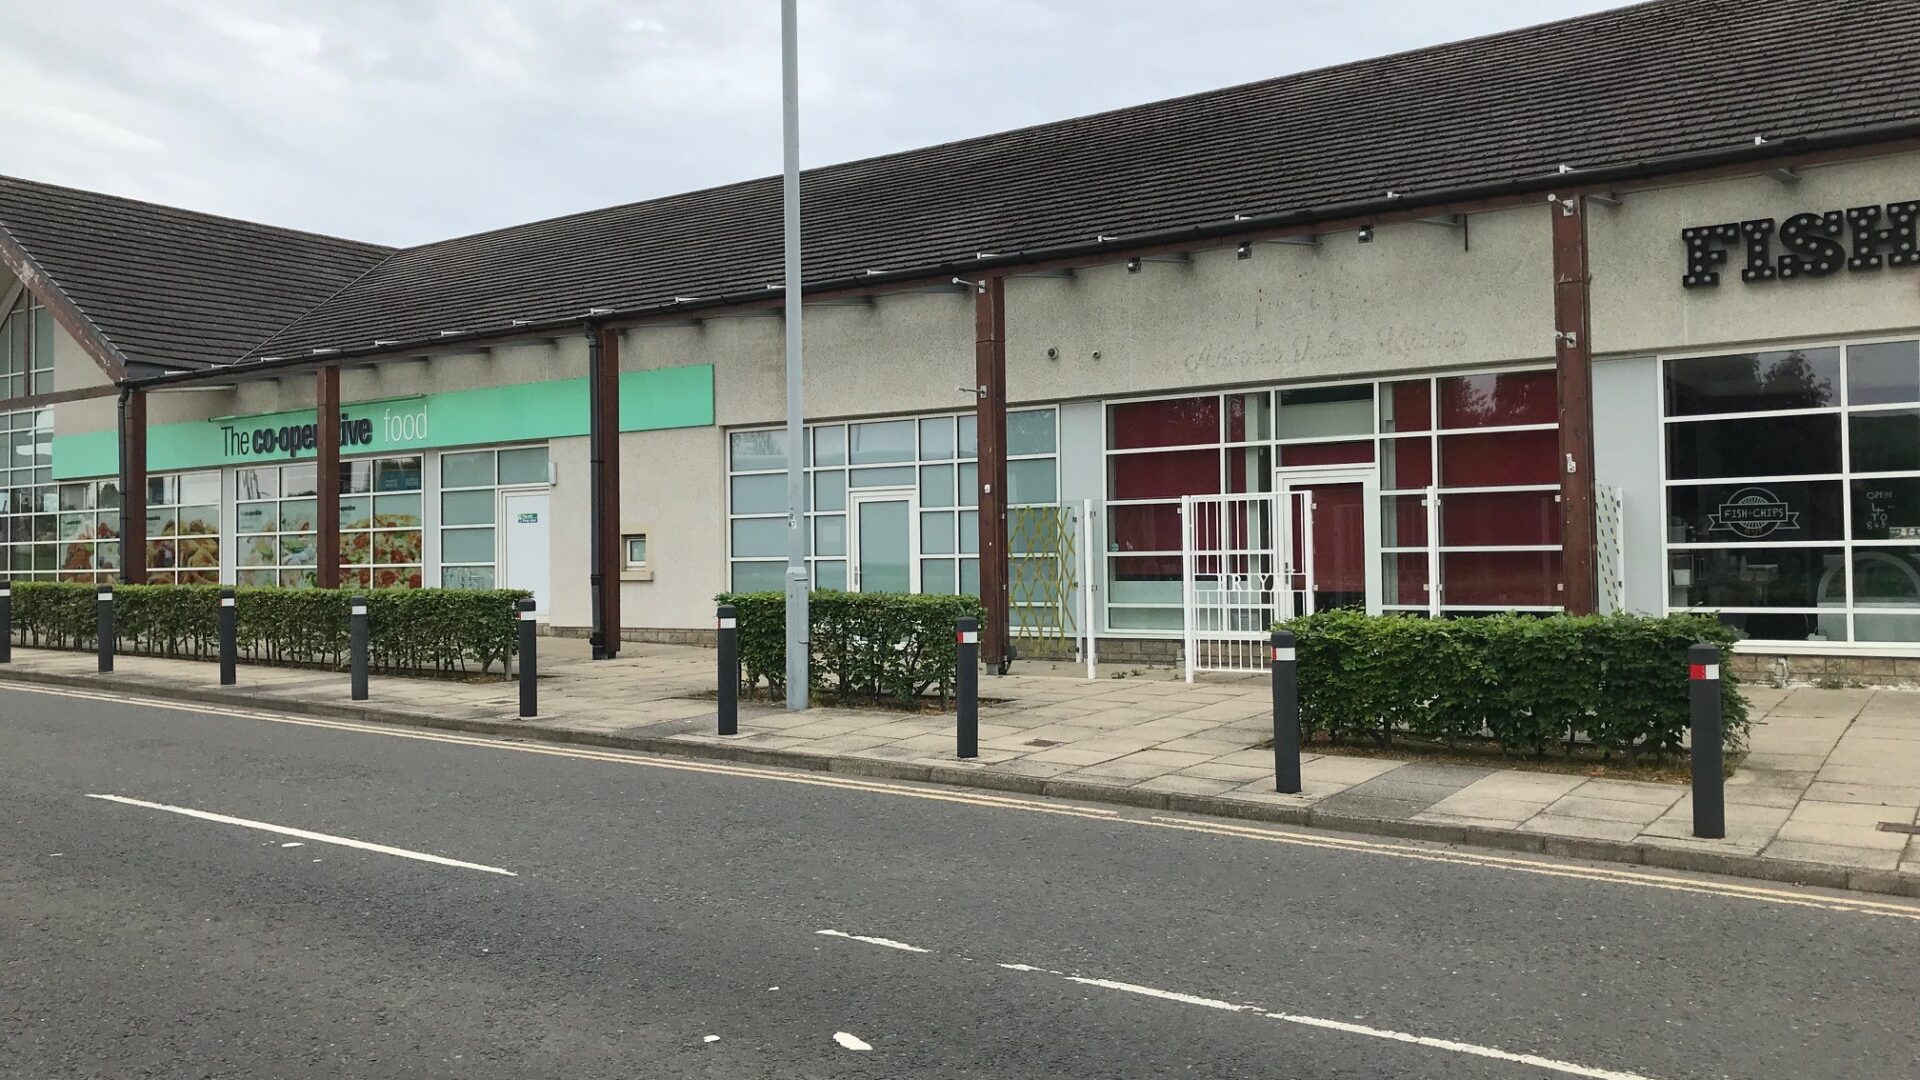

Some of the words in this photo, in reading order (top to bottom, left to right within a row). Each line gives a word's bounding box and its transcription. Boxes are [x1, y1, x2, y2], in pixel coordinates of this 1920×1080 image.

[1682, 200, 1920, 287] FISH
[221, 425, 249, 457] The
[252, 413, 373, 457] co-opeive
[384, 405, 428, 442] food
[1866, 491, 1893, 500] OPEN
[1724, 509, 1748, 518] FISH
[1753, 508, 1784, 518] CHIPS
